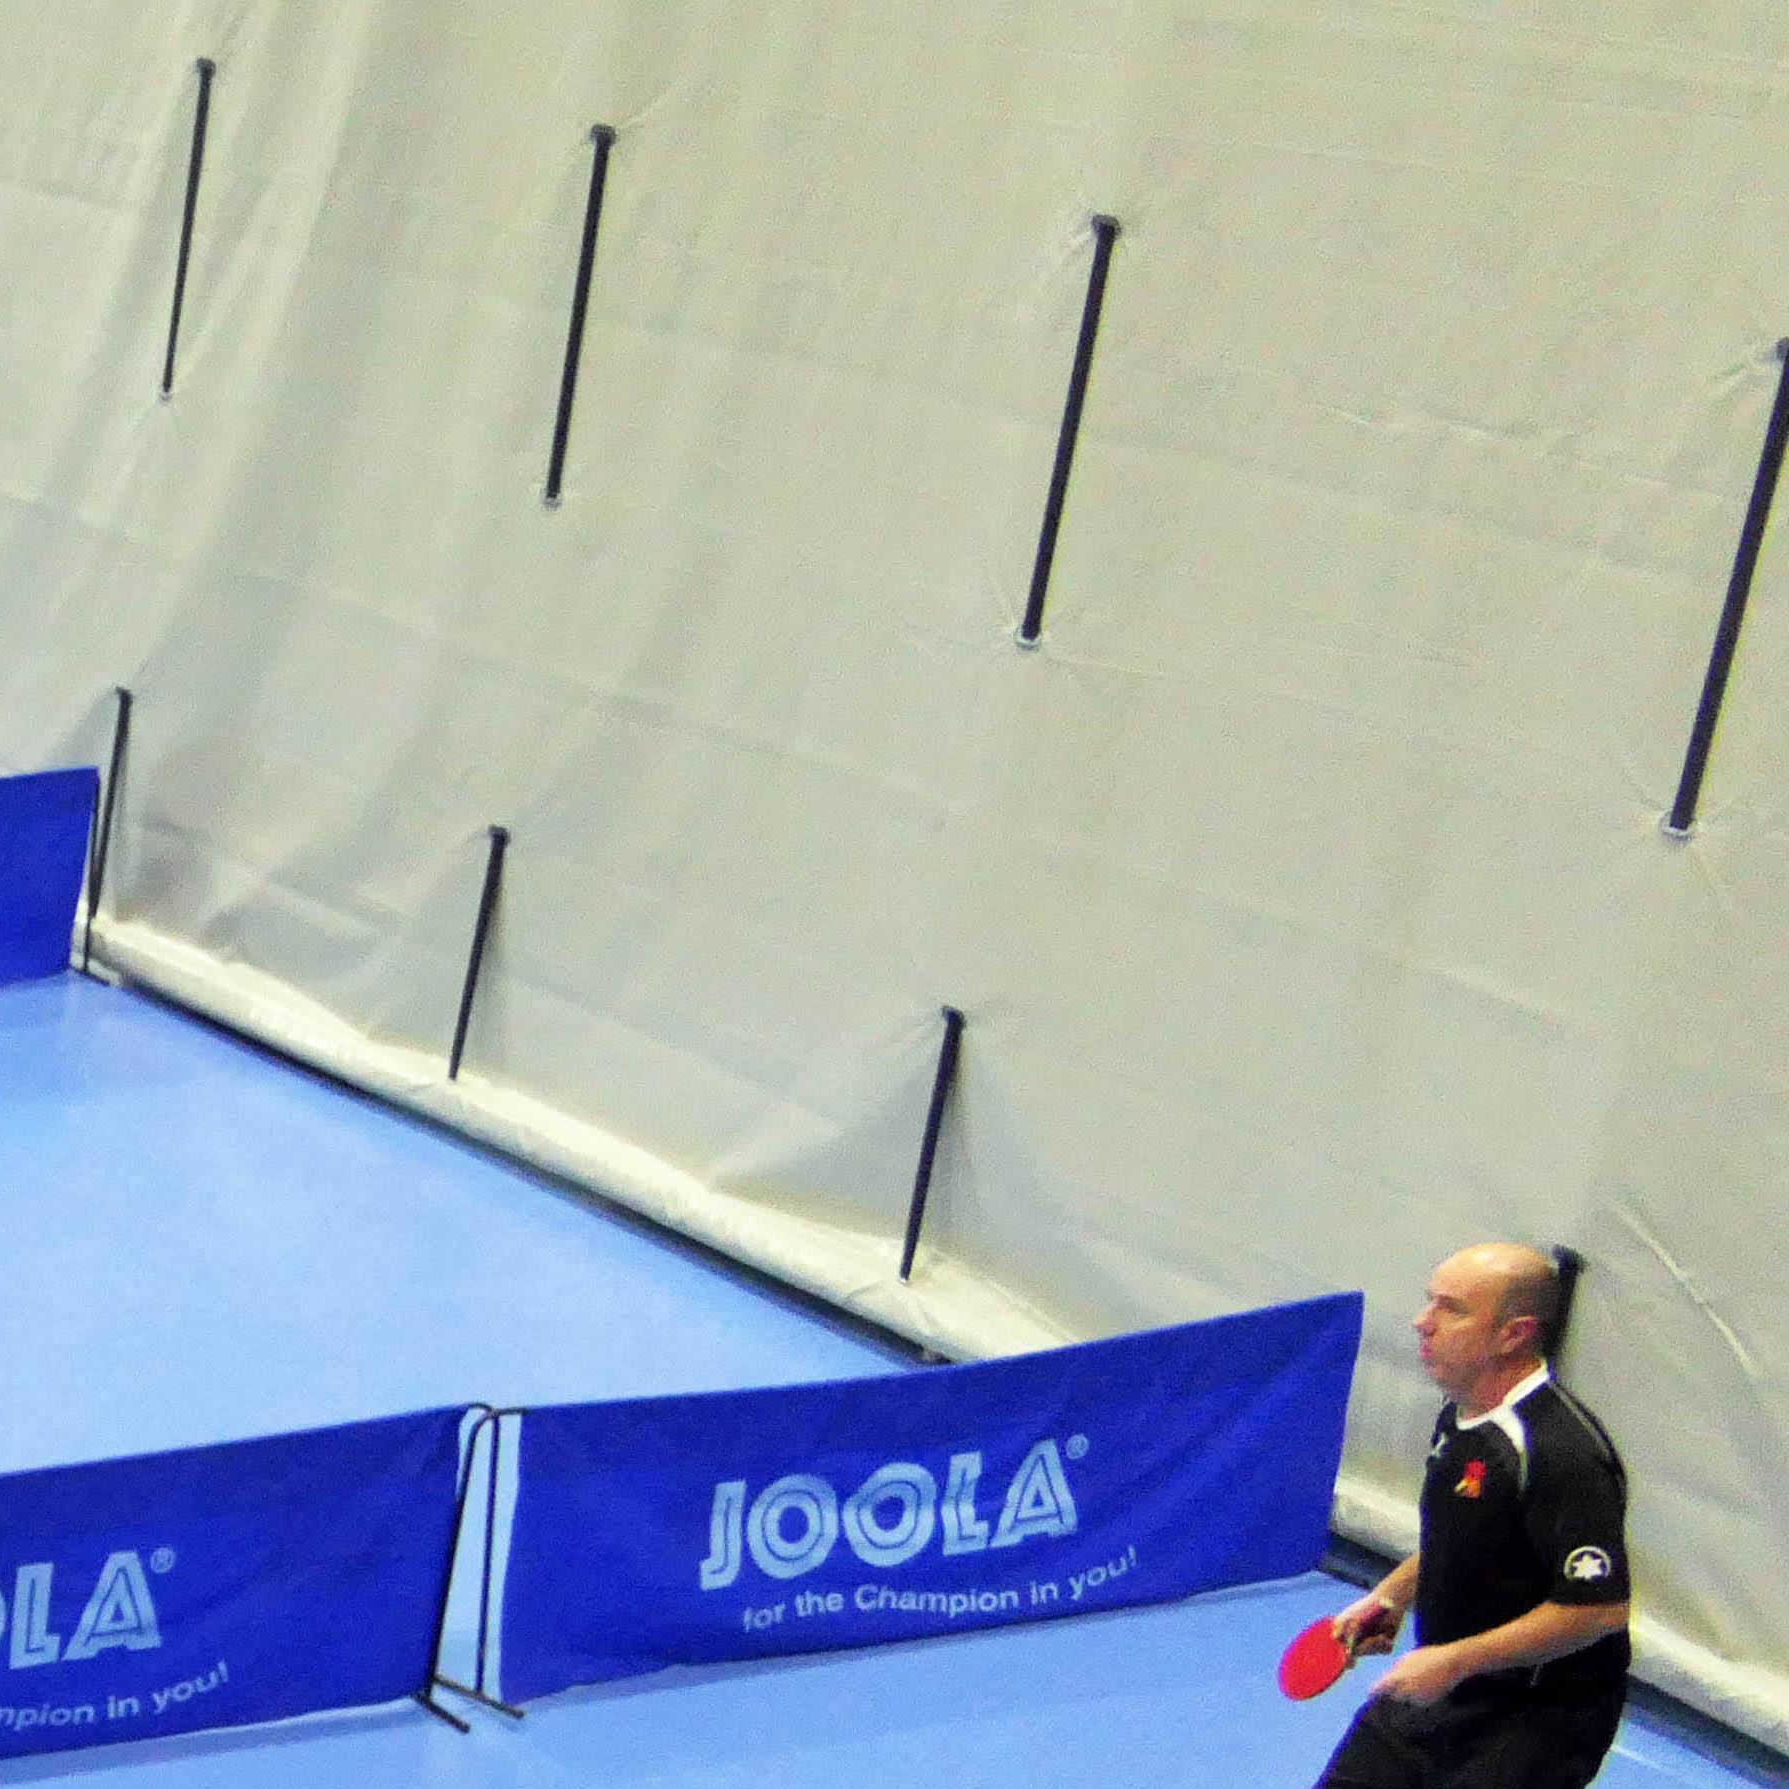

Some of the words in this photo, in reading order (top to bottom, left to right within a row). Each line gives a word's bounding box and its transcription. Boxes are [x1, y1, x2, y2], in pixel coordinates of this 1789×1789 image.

[700, 1437, 1078, 1591] JOOLA
[743, 1603, 785, 1633] for
[795, 1587, 844, 1614] the
[854, 1583, 1019, 1618] Champion
[1030, 1580, 1059, 1606] in
[1070, 1546, 1138, 1598] you!
[107, 1695, 139, 1719] in
[152, 1660, 230, 1714] you!
